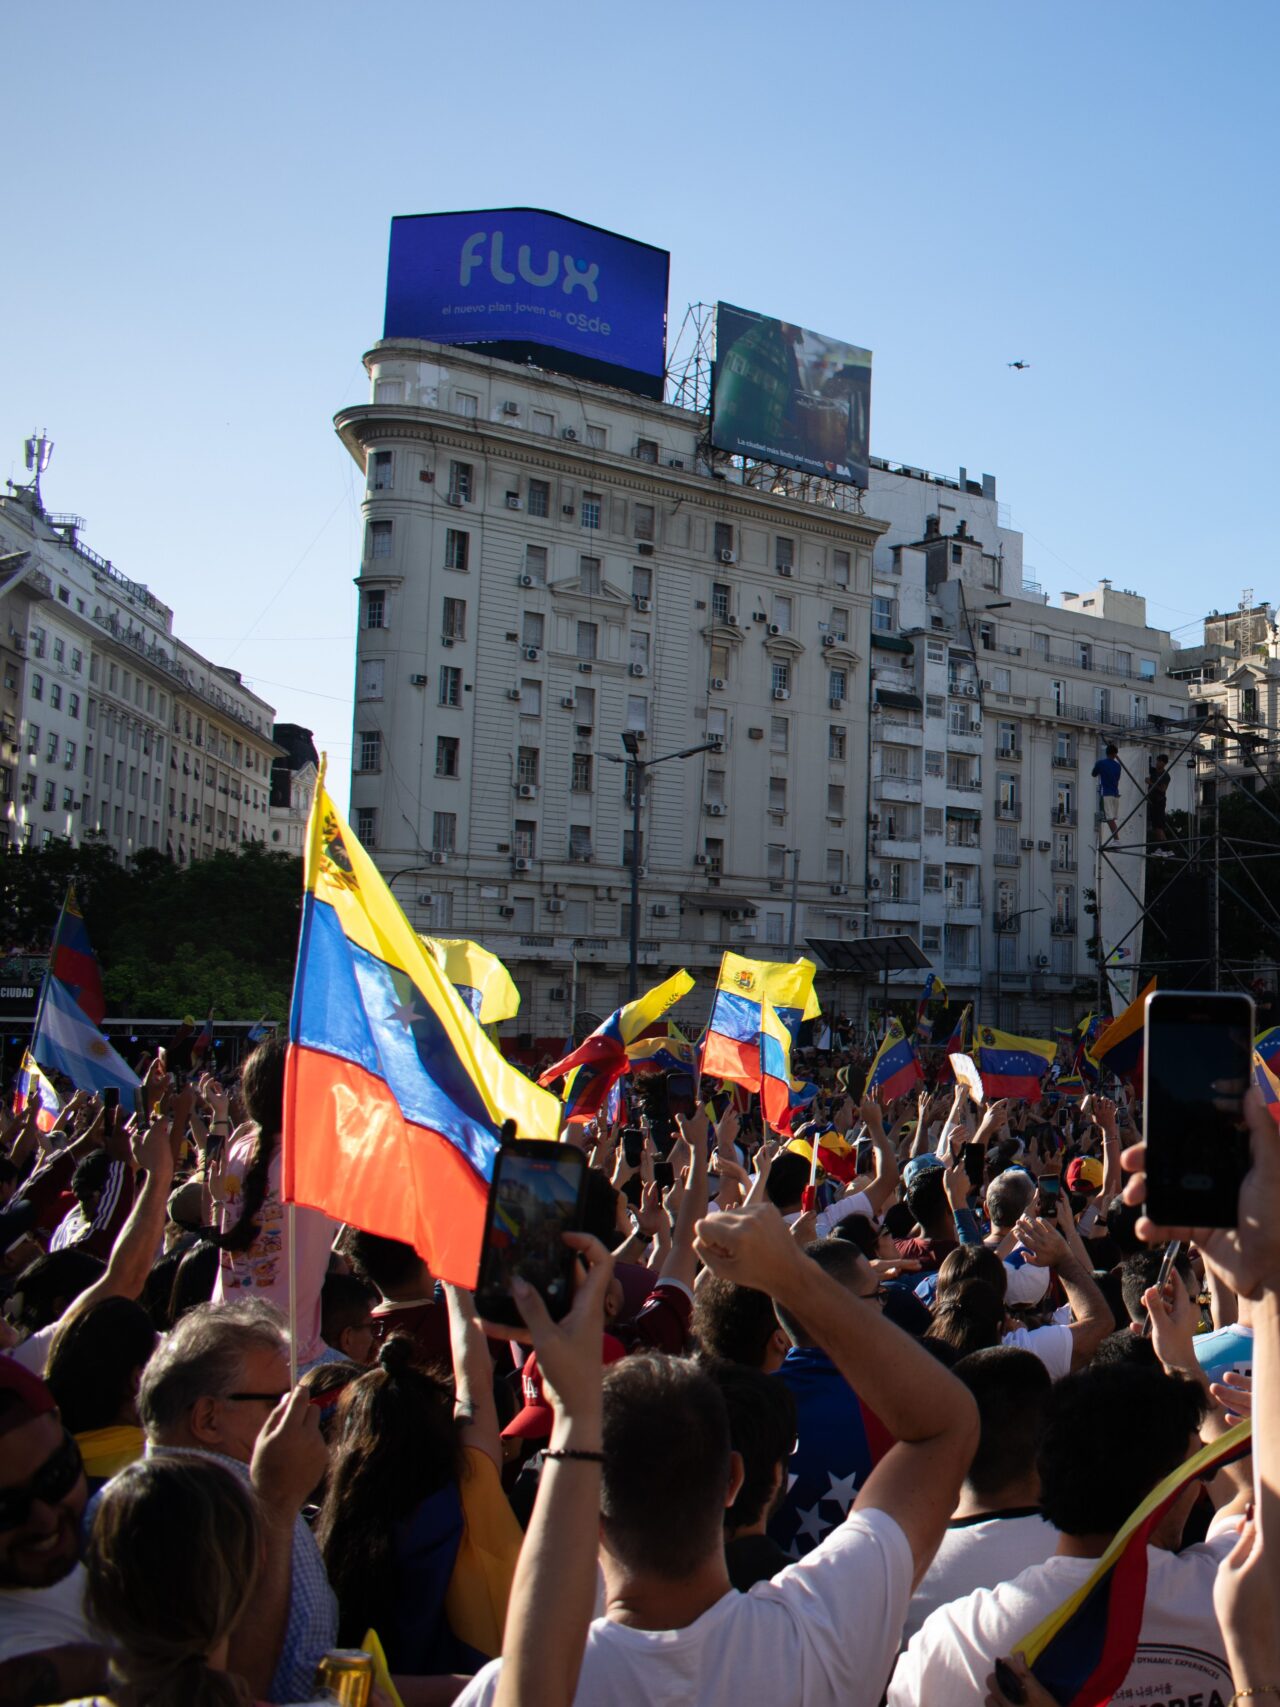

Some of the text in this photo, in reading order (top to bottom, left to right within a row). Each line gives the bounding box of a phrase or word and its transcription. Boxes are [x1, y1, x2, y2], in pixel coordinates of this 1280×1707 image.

[442, 302, 611, 336] el nuevo plan joven de osde
[0, 987, 34, 998] CIUDAD
[522, 1374, 537, 1398] LA
[1137, 1656, 1172, 1665] DYNAMIC
[1174, 1658, 1220, 1680] EXPERIENCES
